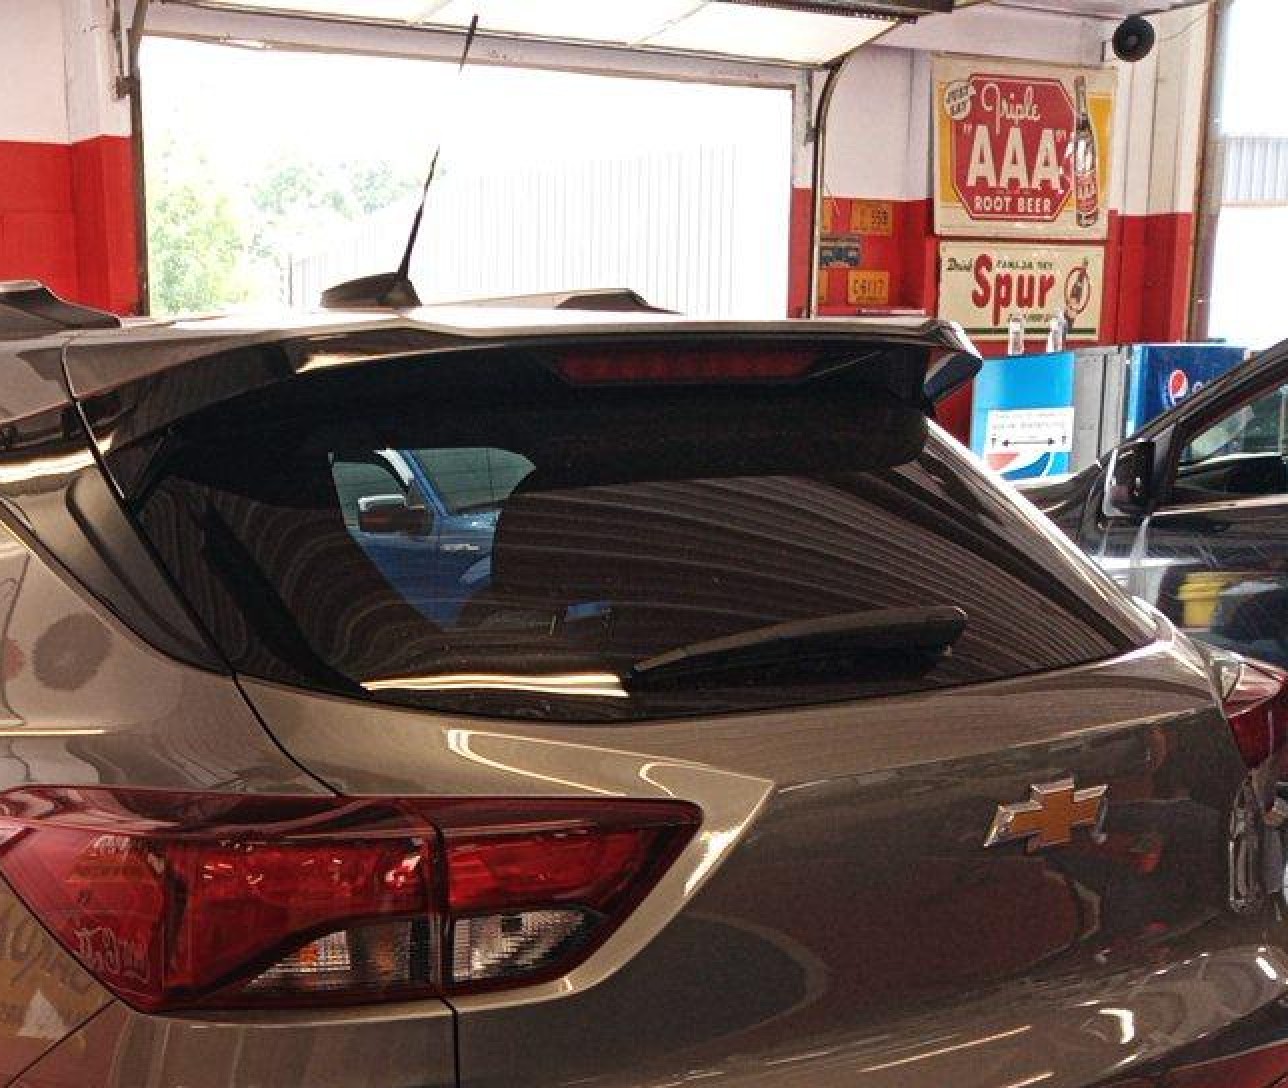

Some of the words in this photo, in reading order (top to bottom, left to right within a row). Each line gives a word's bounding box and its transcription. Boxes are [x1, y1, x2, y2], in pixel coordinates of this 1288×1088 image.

[981, 83, 1040, 135] Triple
[973, 195, 1012, 211] ROOT
[1017, 197, 1051, 213] BEER
[971, 253, 1057, 327] Spur
